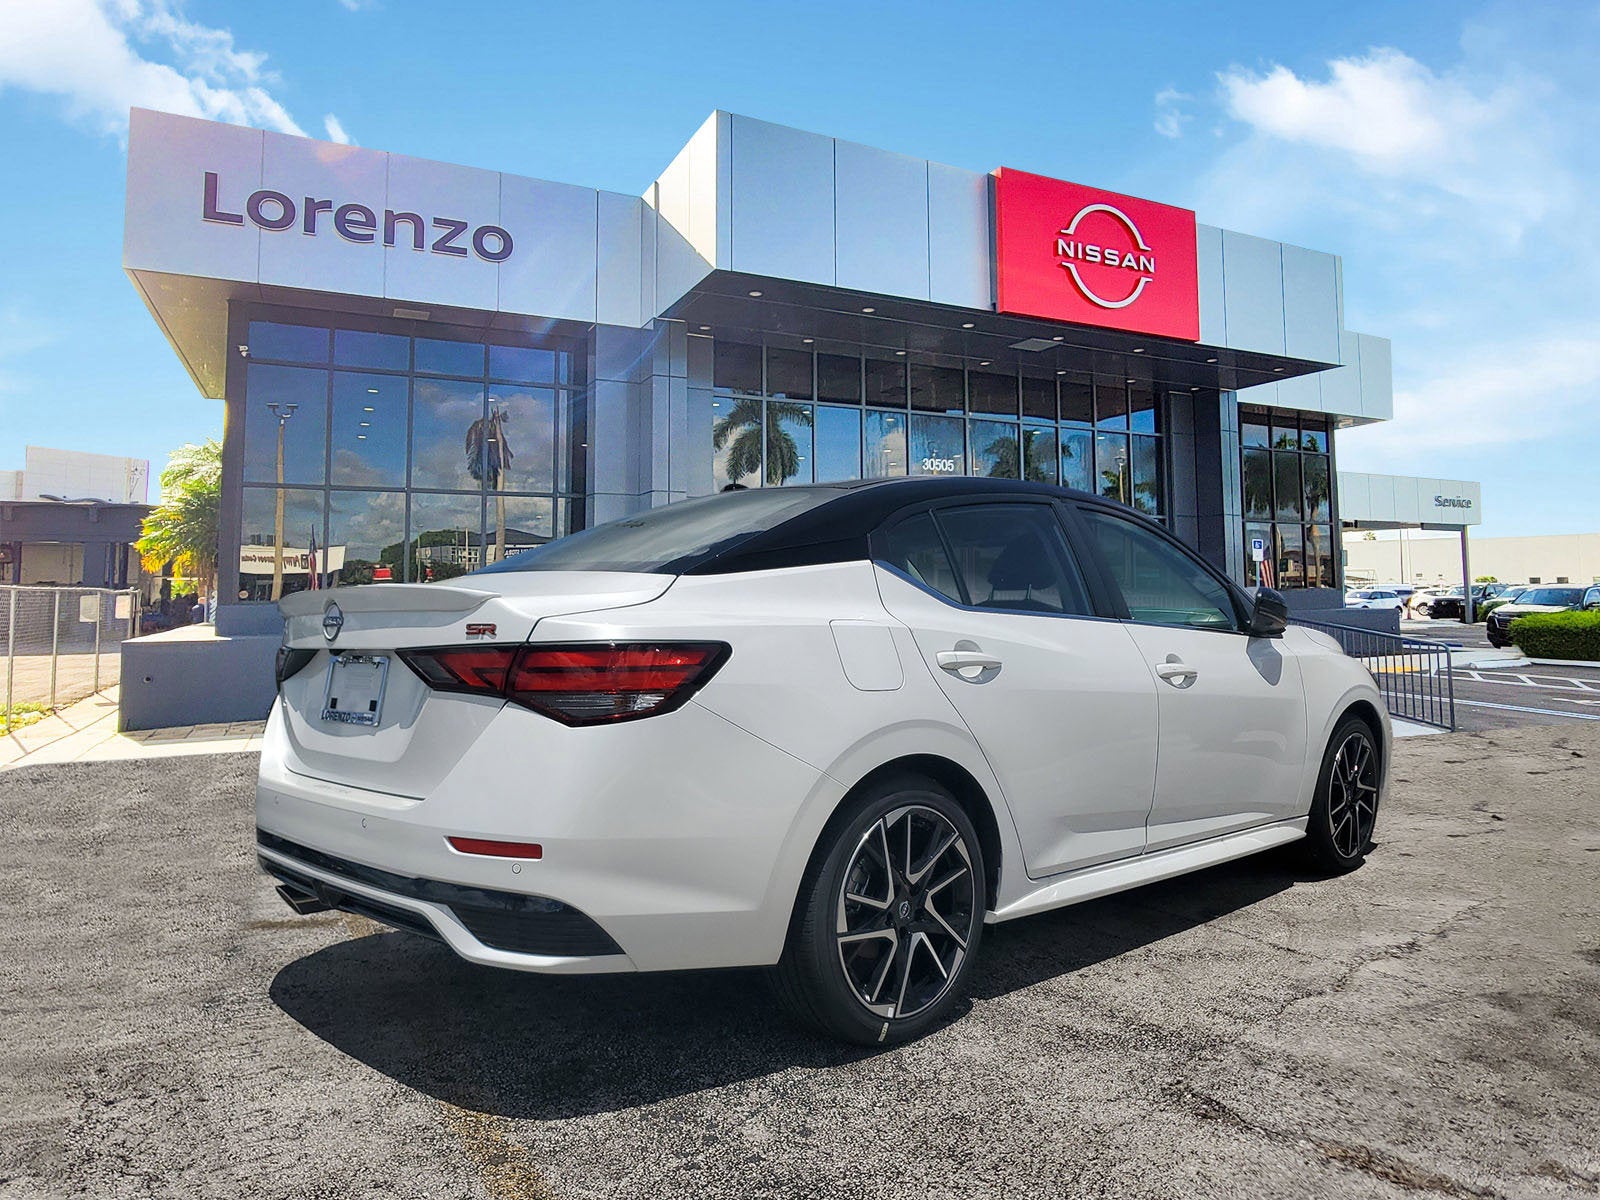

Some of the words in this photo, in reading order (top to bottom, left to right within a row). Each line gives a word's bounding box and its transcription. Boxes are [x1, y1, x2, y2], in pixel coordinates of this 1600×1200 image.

[201, 170, 514, 263] Lorenzo
[1057, 237, 1155, 273] NISSAN
[922, 457, 954, 472] 30505
[1434, 495, 1472, 509] Service
[465, 623, 497, 636] SR
[321, 709, 351, 723] LORENZO
